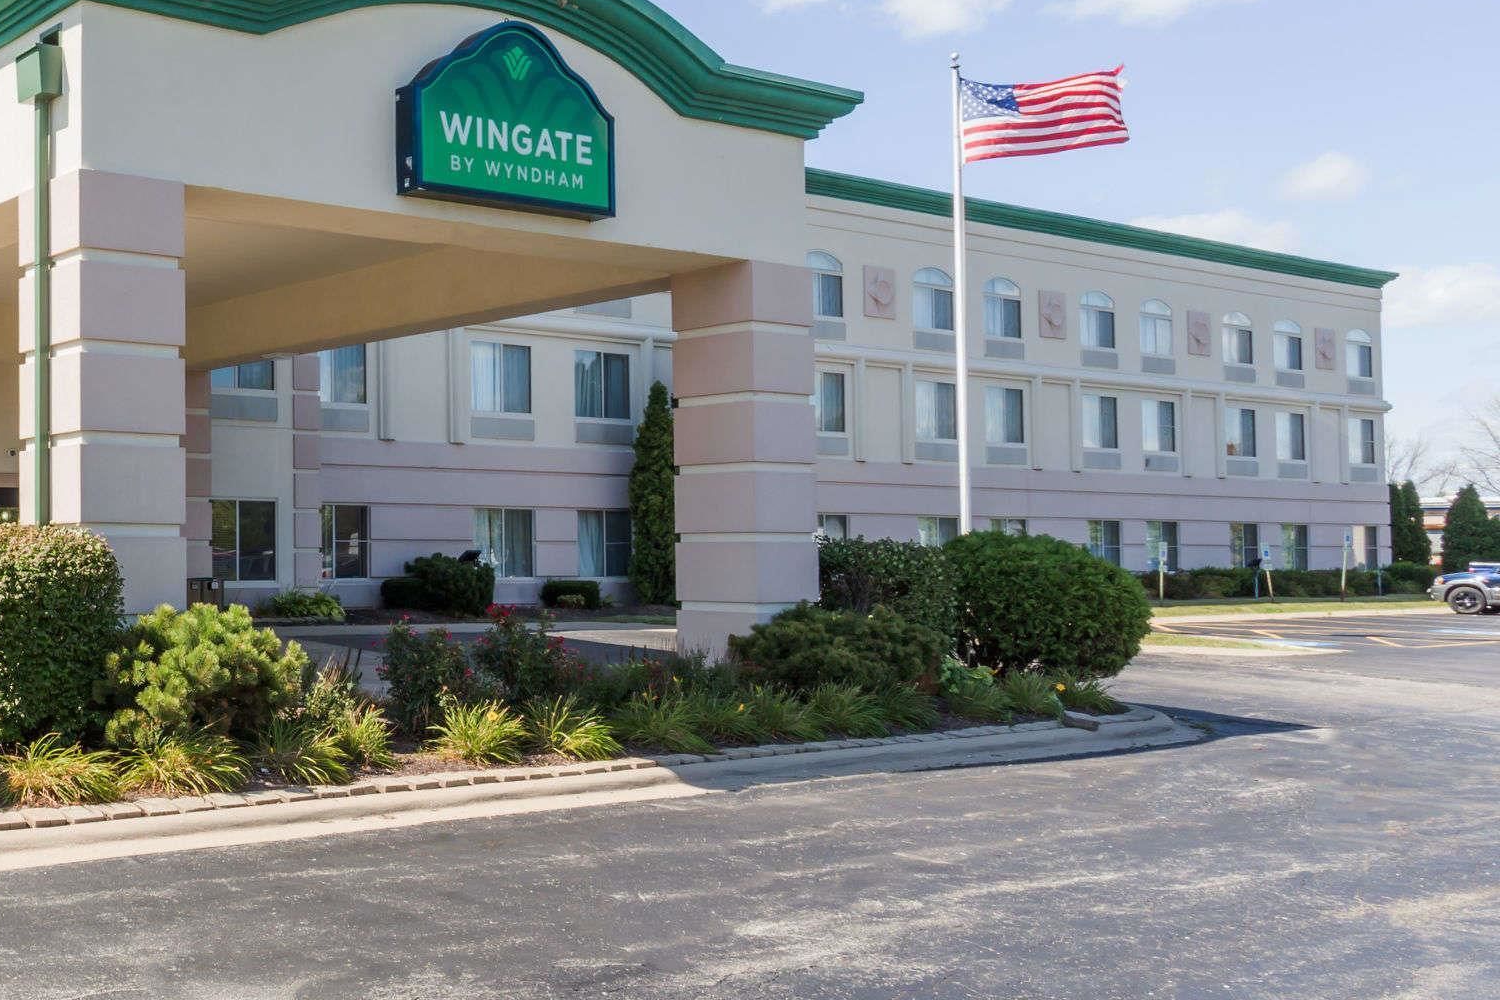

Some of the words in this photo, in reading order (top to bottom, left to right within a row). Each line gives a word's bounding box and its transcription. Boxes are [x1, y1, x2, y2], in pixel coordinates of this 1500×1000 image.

[439, 110, 593, 166] WINGATE
[451, 154, 475, 173] BY
[484, 159, 584, 190] WYNDHAM
